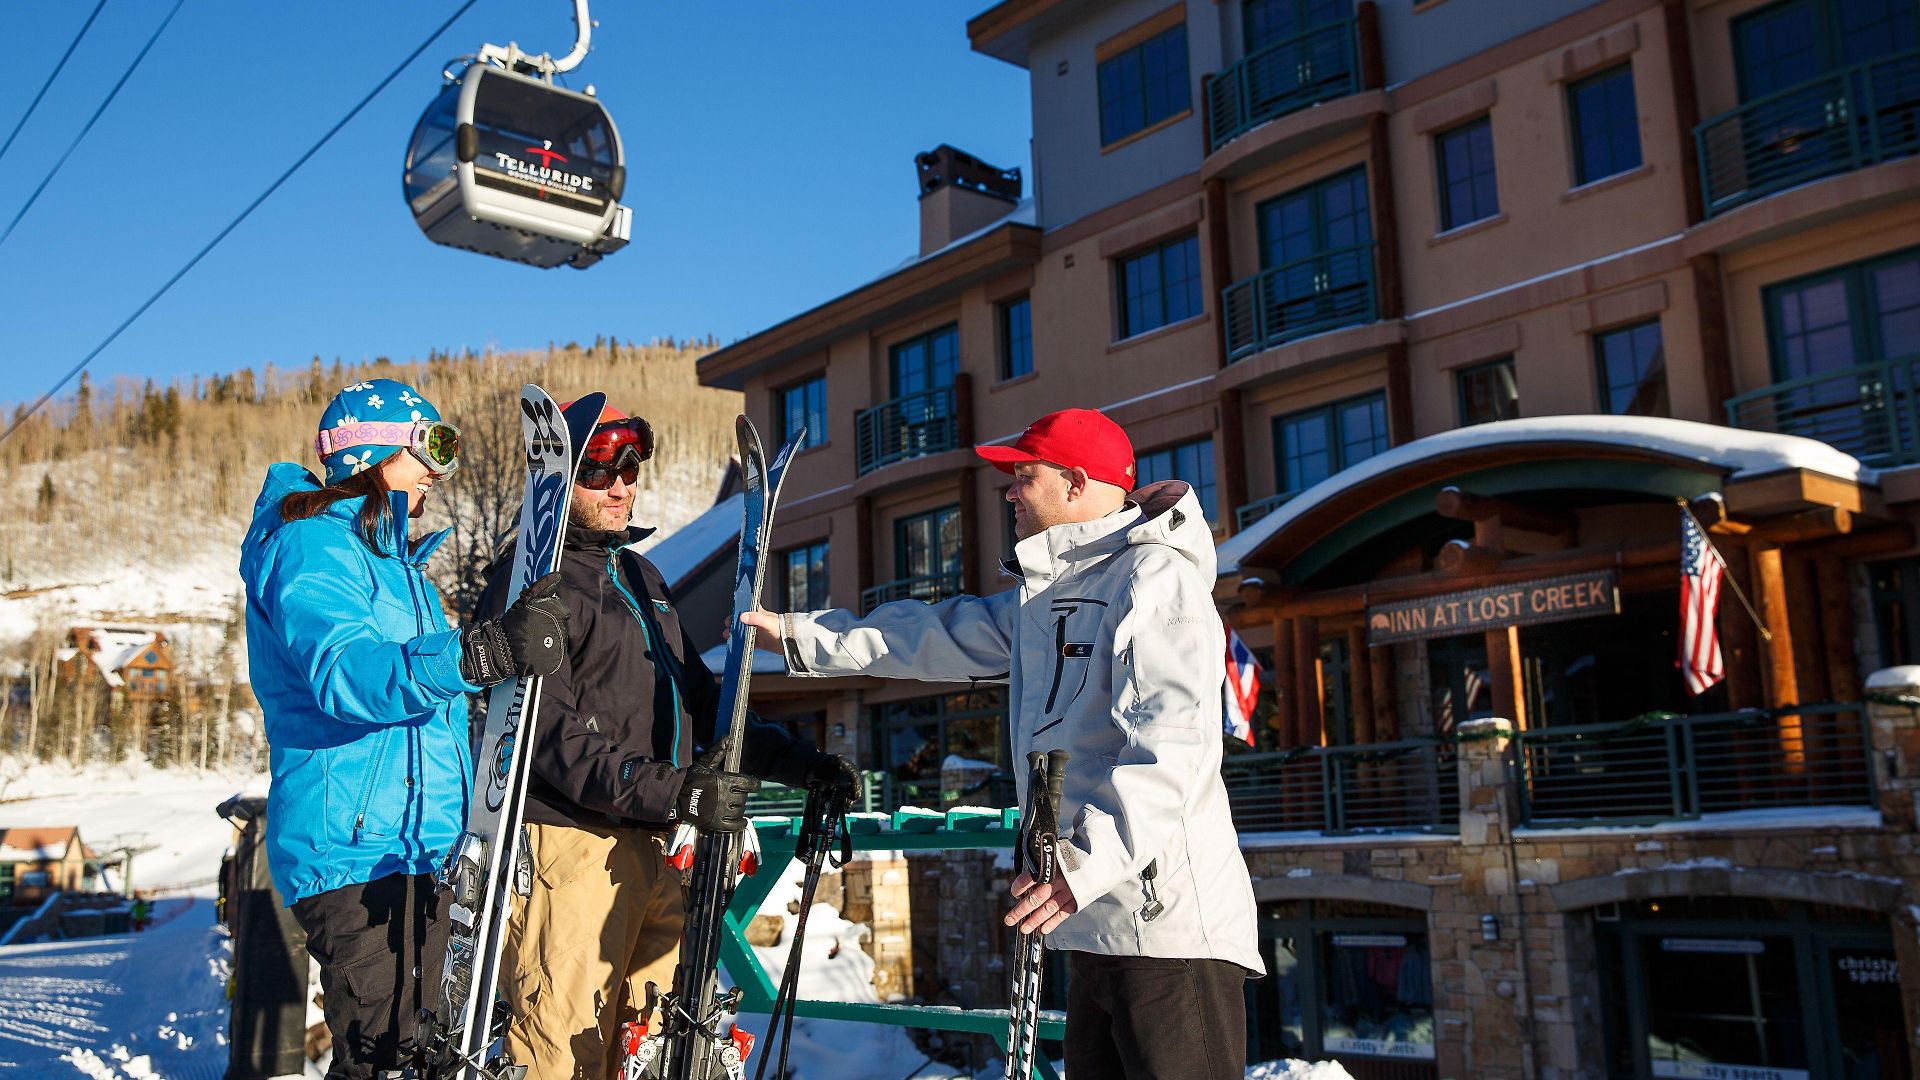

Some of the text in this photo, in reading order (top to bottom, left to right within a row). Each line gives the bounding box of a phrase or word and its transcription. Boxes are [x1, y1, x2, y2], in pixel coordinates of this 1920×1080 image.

[495, 152, 593, 191] TELLURIDE
[1390, 580, 1607, 634] INN AT LOST CREEK
[477, 644, 491, 678] Marmot
